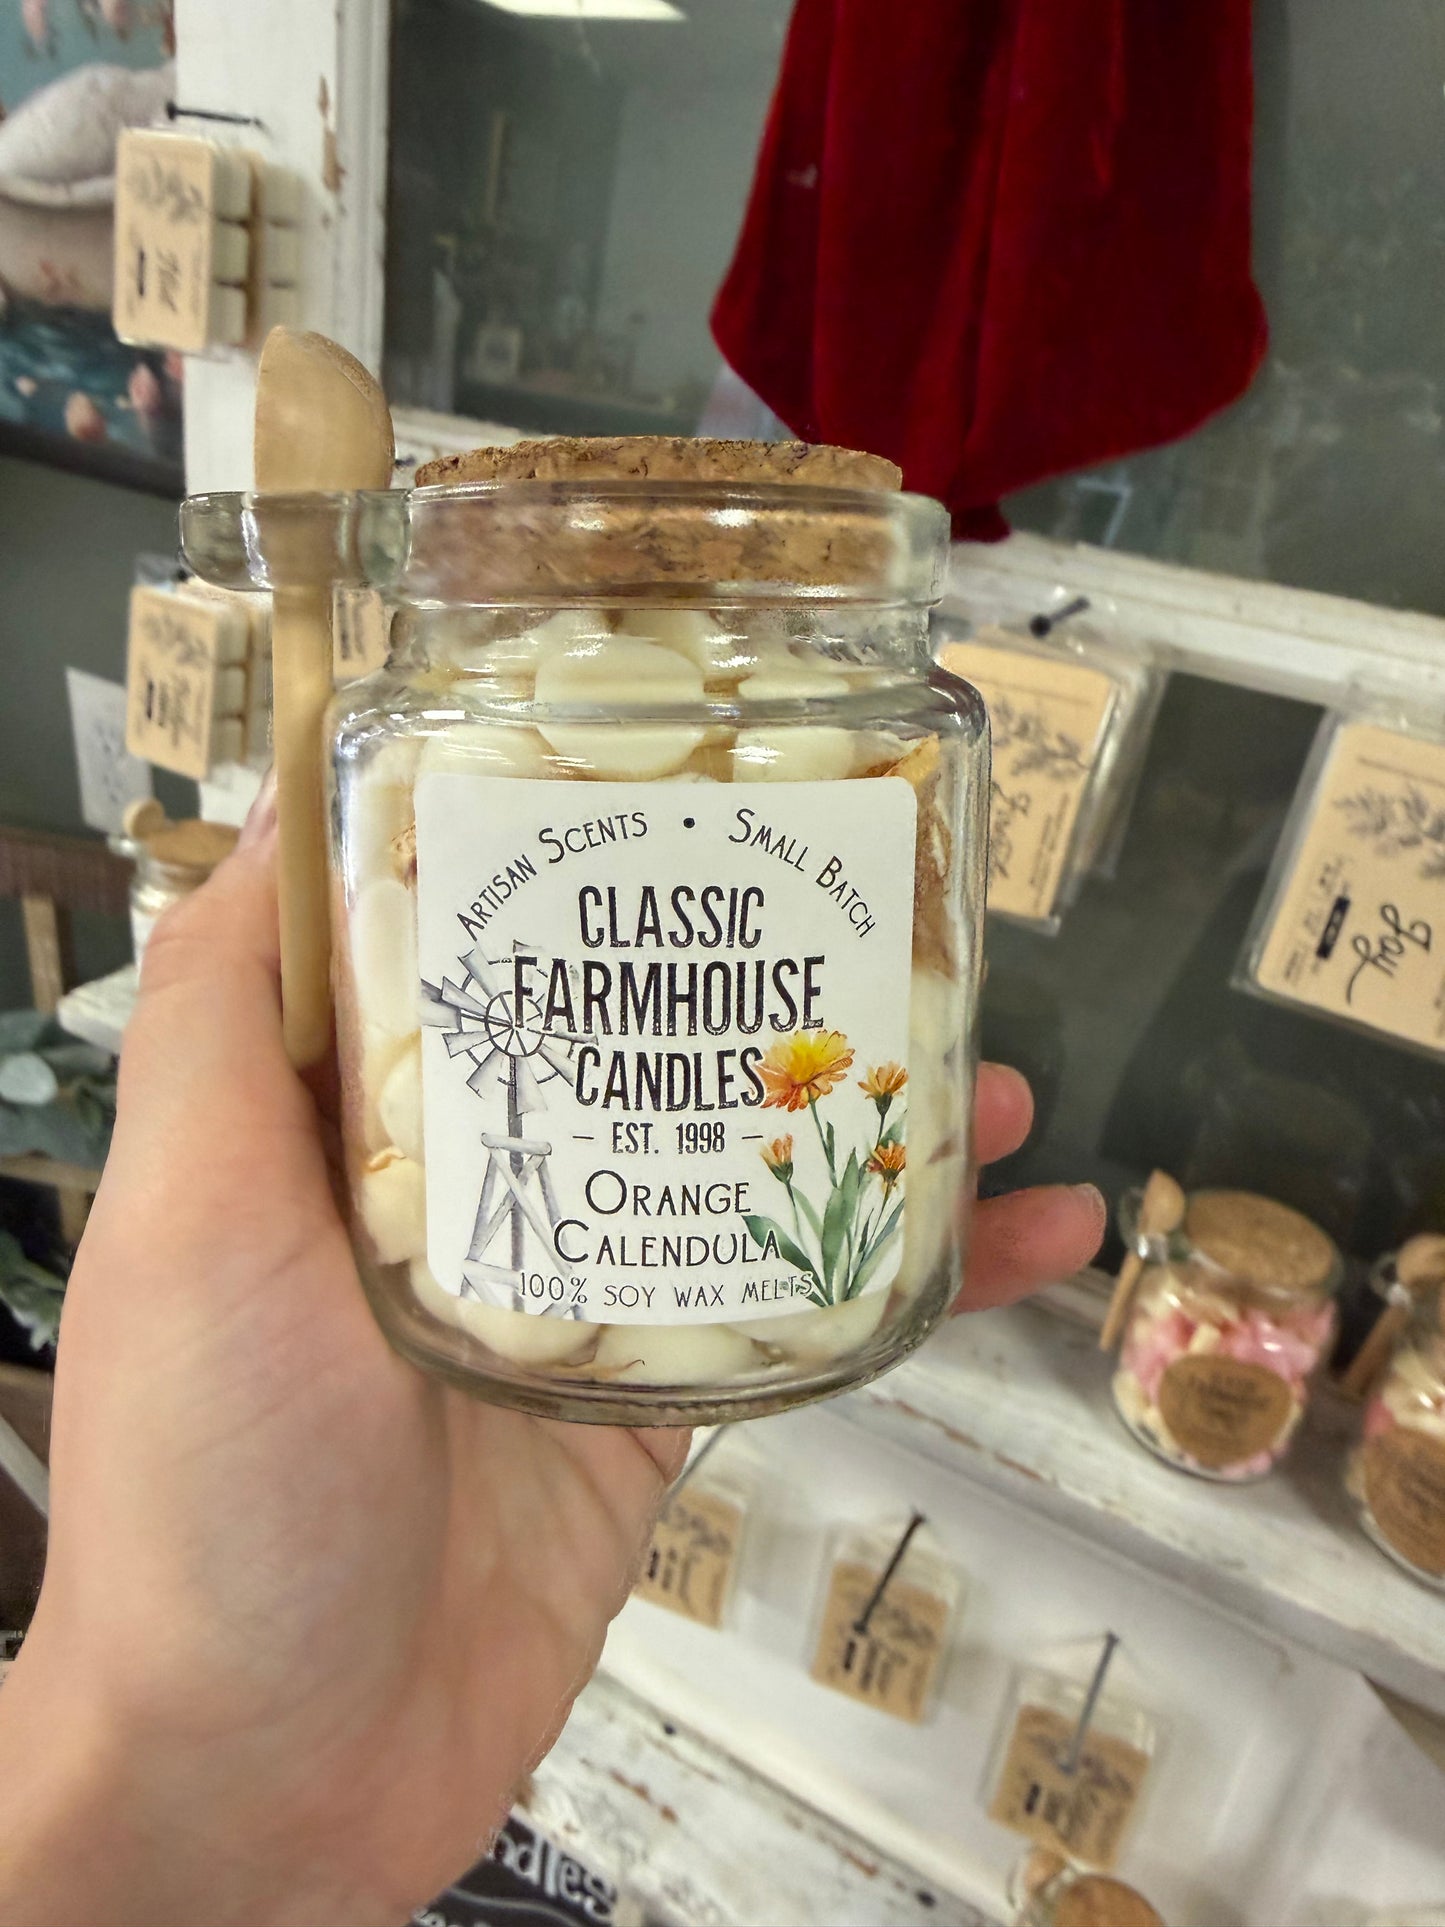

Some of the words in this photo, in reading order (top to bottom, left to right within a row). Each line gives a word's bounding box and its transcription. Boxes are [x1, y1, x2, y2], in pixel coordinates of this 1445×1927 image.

[457, 853, 538, 942] ARTISAN
[538, 812, 648, 864] SCENTS
[728, 808, 806, 871] SMALL
[816, 855, 876, 938] BATCH
[578, 885, 765, 949] CLASSIC
[513, 954, 826, 1036] FARMHOUSE
[575, 1046, 766, 1112] CANDLES
[612, 1122, 659, 1154] EST.
[676, 1121, 726, 1154] 1998
[585, 1169, 751, 1216] ORANGE
[554, 1219, 780, 1267] CALENDULA
[520, 1272, 588, 1304] 100%
[603, 1285, 656, 1308] SOY
[673, 1284, 725, 1308] WAX
[741, 1272, 813, 1304] MELTS
[489, 1830, 614, 1922] ndles
